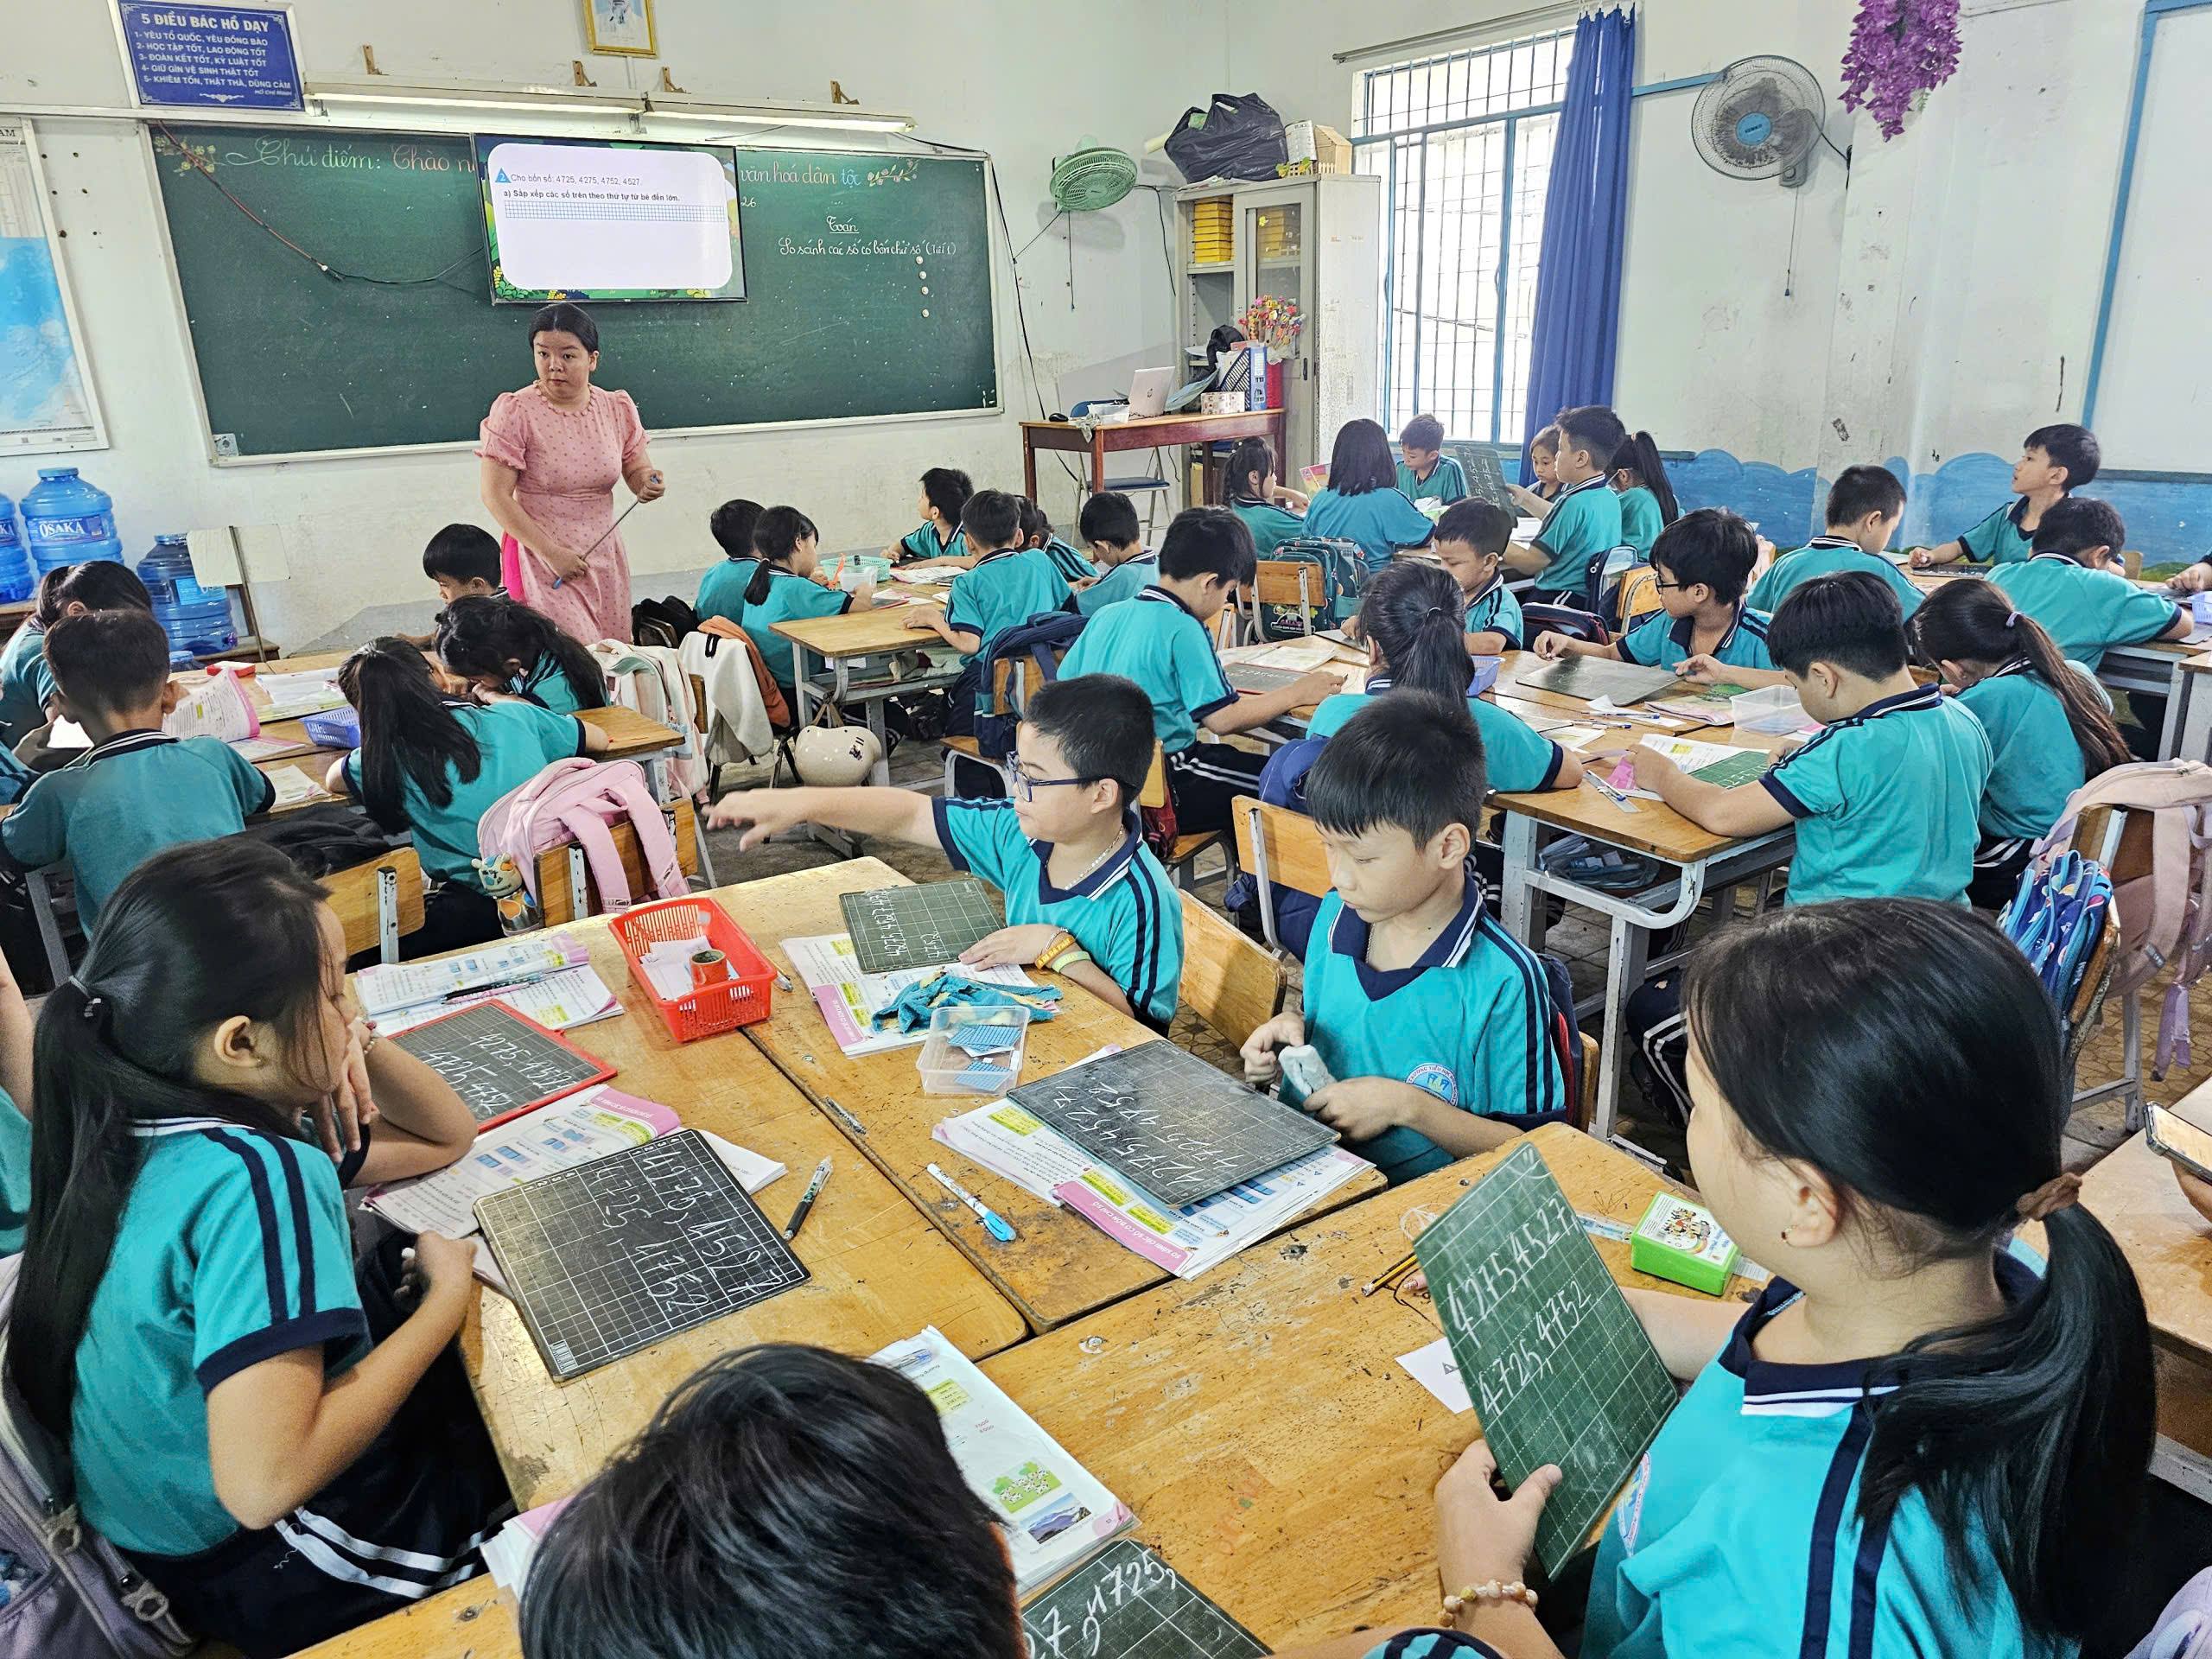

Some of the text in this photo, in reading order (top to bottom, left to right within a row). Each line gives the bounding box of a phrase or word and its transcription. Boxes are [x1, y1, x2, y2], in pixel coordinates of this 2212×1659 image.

[141, 10, 269, 34] 5 ĐIỀU BÁC HỒ DẠY
[143, 30, 162, 40] YÊU
[206, 35, 223, 43] YÊU
[198, 67, 219, 75] SINH
[499, 173, 506, 182] 2
[528, 173, 542, 182] bốn
[556, 175, 577, 185] 4725,
[578, 176, 600, 185] 4275,
[601, 177, 621, 186] 4752,
[741, 161, 861, 188] văn hoá dân tộc
[504, 189, 512, 198] a)
[530, 188, 544, 199] xếp
[561, 189, 570, 198] số
[588, 191, 605, 200] theo
[620, 193, 630, 201] tự
[826, 216, 859, 233] Toán
[778, 236, 796, 256] So
[797, 238, 826, 256] sánh
[828, 241, 844, 255] các
[846, 238, 861, 255] số
[861, 241, 873, 255] có
[873, 238, 890, 255] bốn
[39, 520, 86, 538] OSAKA
[1535, 1280, 1592, 1350] 4752
